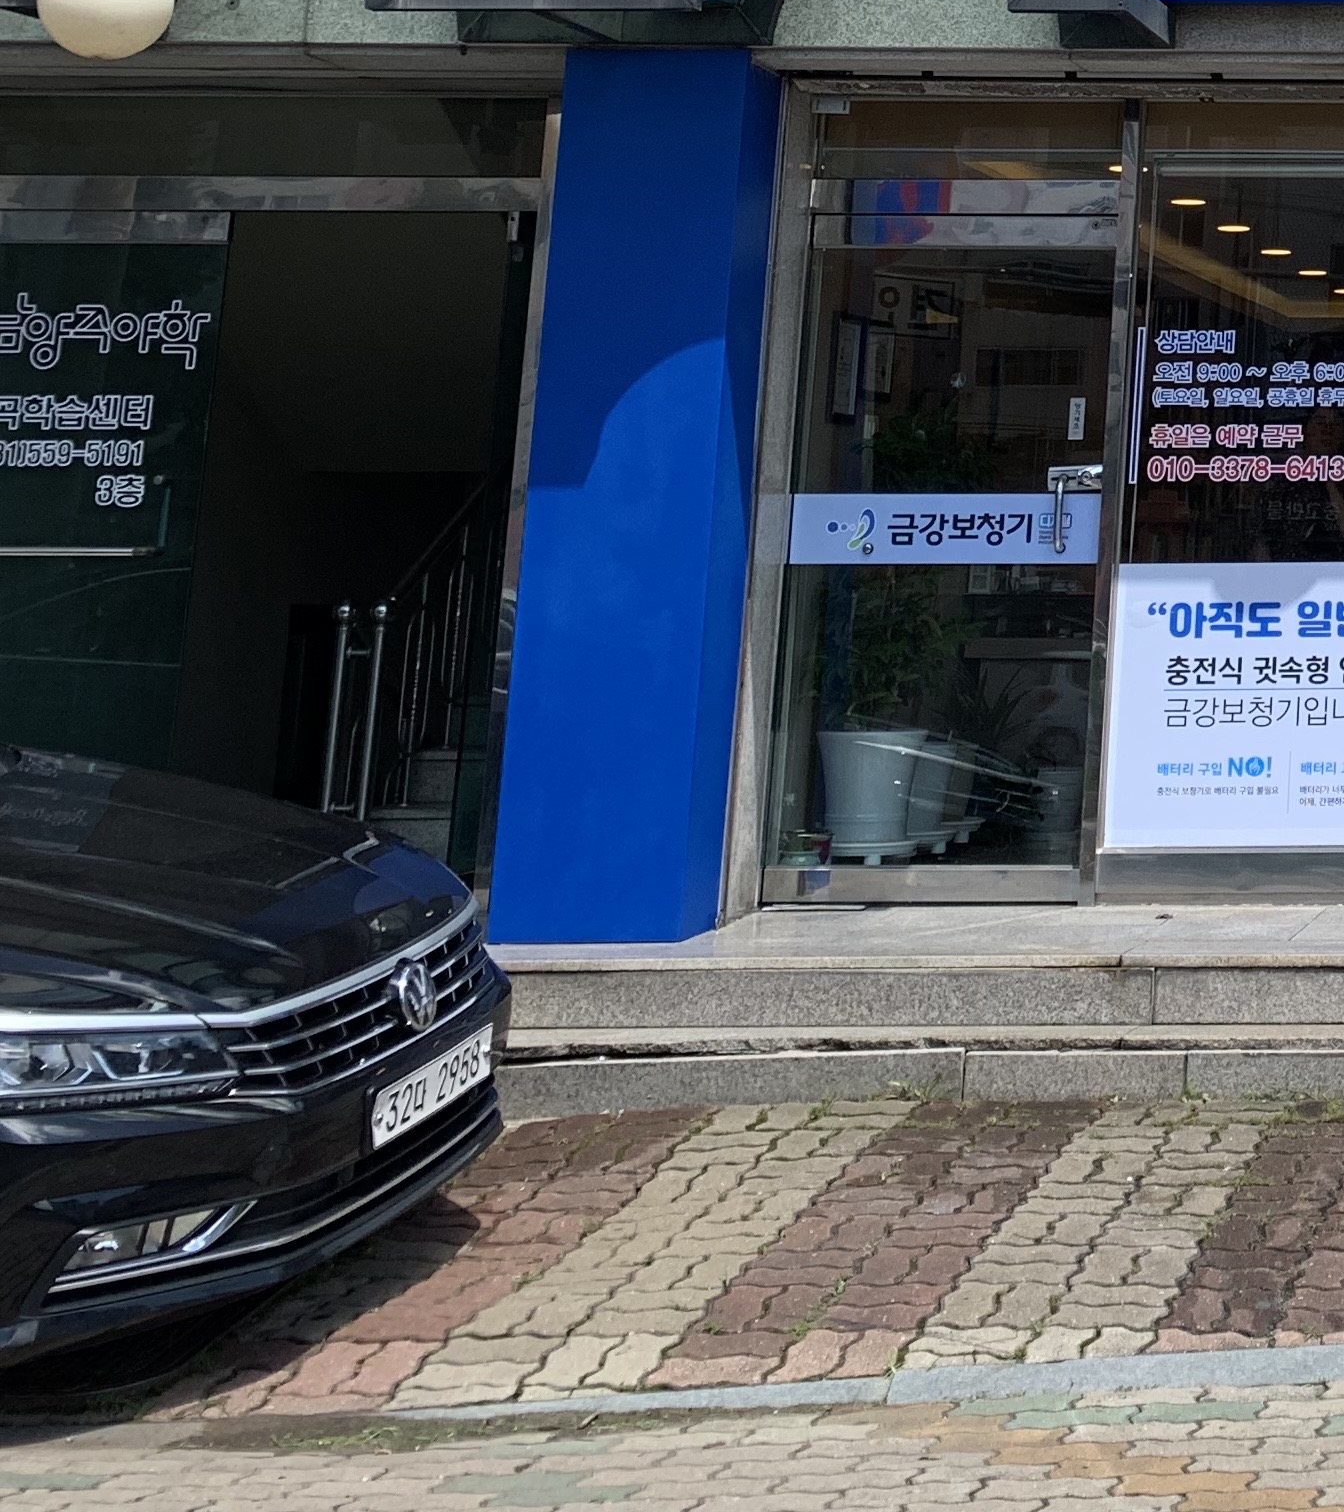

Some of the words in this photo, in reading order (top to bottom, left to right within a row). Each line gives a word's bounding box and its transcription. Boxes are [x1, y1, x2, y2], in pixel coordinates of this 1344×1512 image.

[1155, 330, 1236, 354] 상담안내
[1153, 361, 1193, 383] 오전
[1196, 363, 1242, 382] 9:00
[1270, 361, 1310, 383] 오후
[1213, 387, 1264, 408] 일요일,
[1267, 387, 1315, 407] 공휴일
[1149, 424, 1211, 448] 휴일은
[1216, 424, 1258, 448] 예약
[1261, 424, 1303, 447] 근무
[95, 475, 145, 507] 3층
[887, 513, 1032, 546] 금강보청기
[1165, 654, 1243, 686] 충전식
[1253, 654, 1330, 685] 귓속형
[1157, 763, 1193, 776] 배터리
[1198, 763, 1222, 776] 구입
[1228, 756, 1272, 778] NO!
[1300, 761, 1336, 775] 배터리
[436, 1039, 481, 1104] 2958
